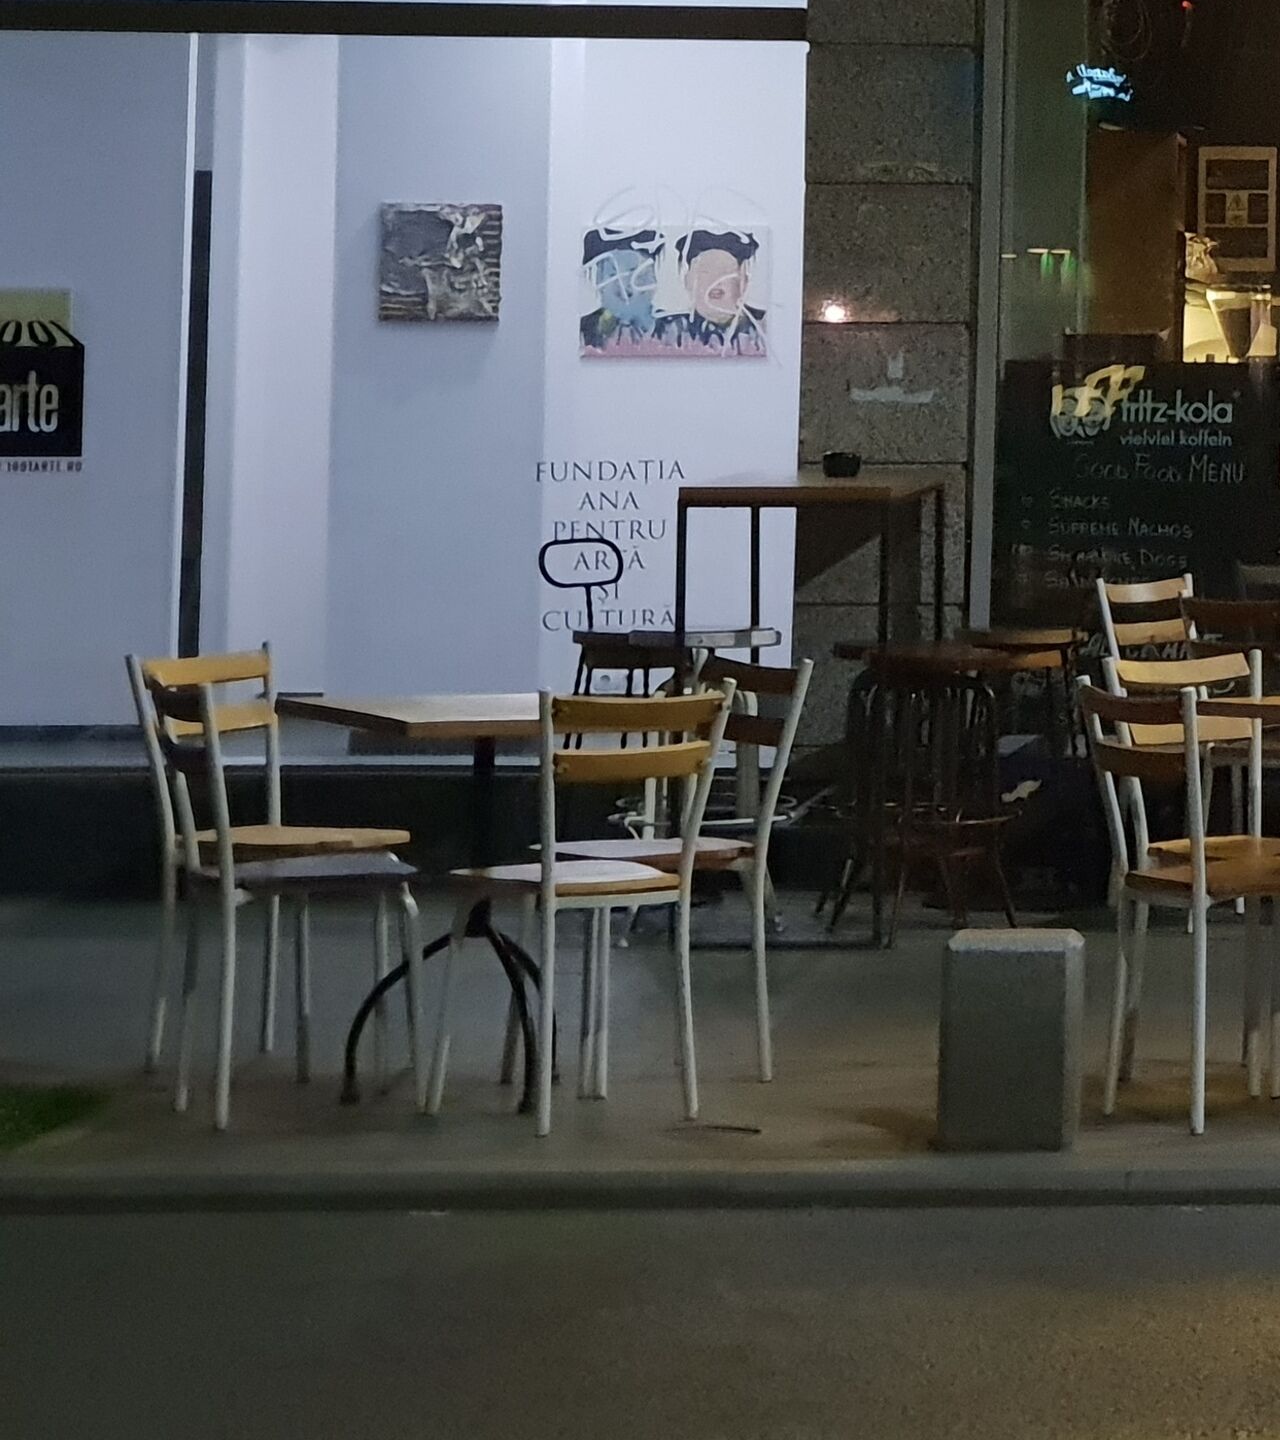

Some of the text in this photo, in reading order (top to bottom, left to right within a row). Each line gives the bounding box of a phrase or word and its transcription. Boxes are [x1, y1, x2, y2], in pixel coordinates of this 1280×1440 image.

[579, 490, 640, 511] ANA
[553, 519, 667, 541] PENTRU
[542, 604, 674, 632] CUTURĂ
